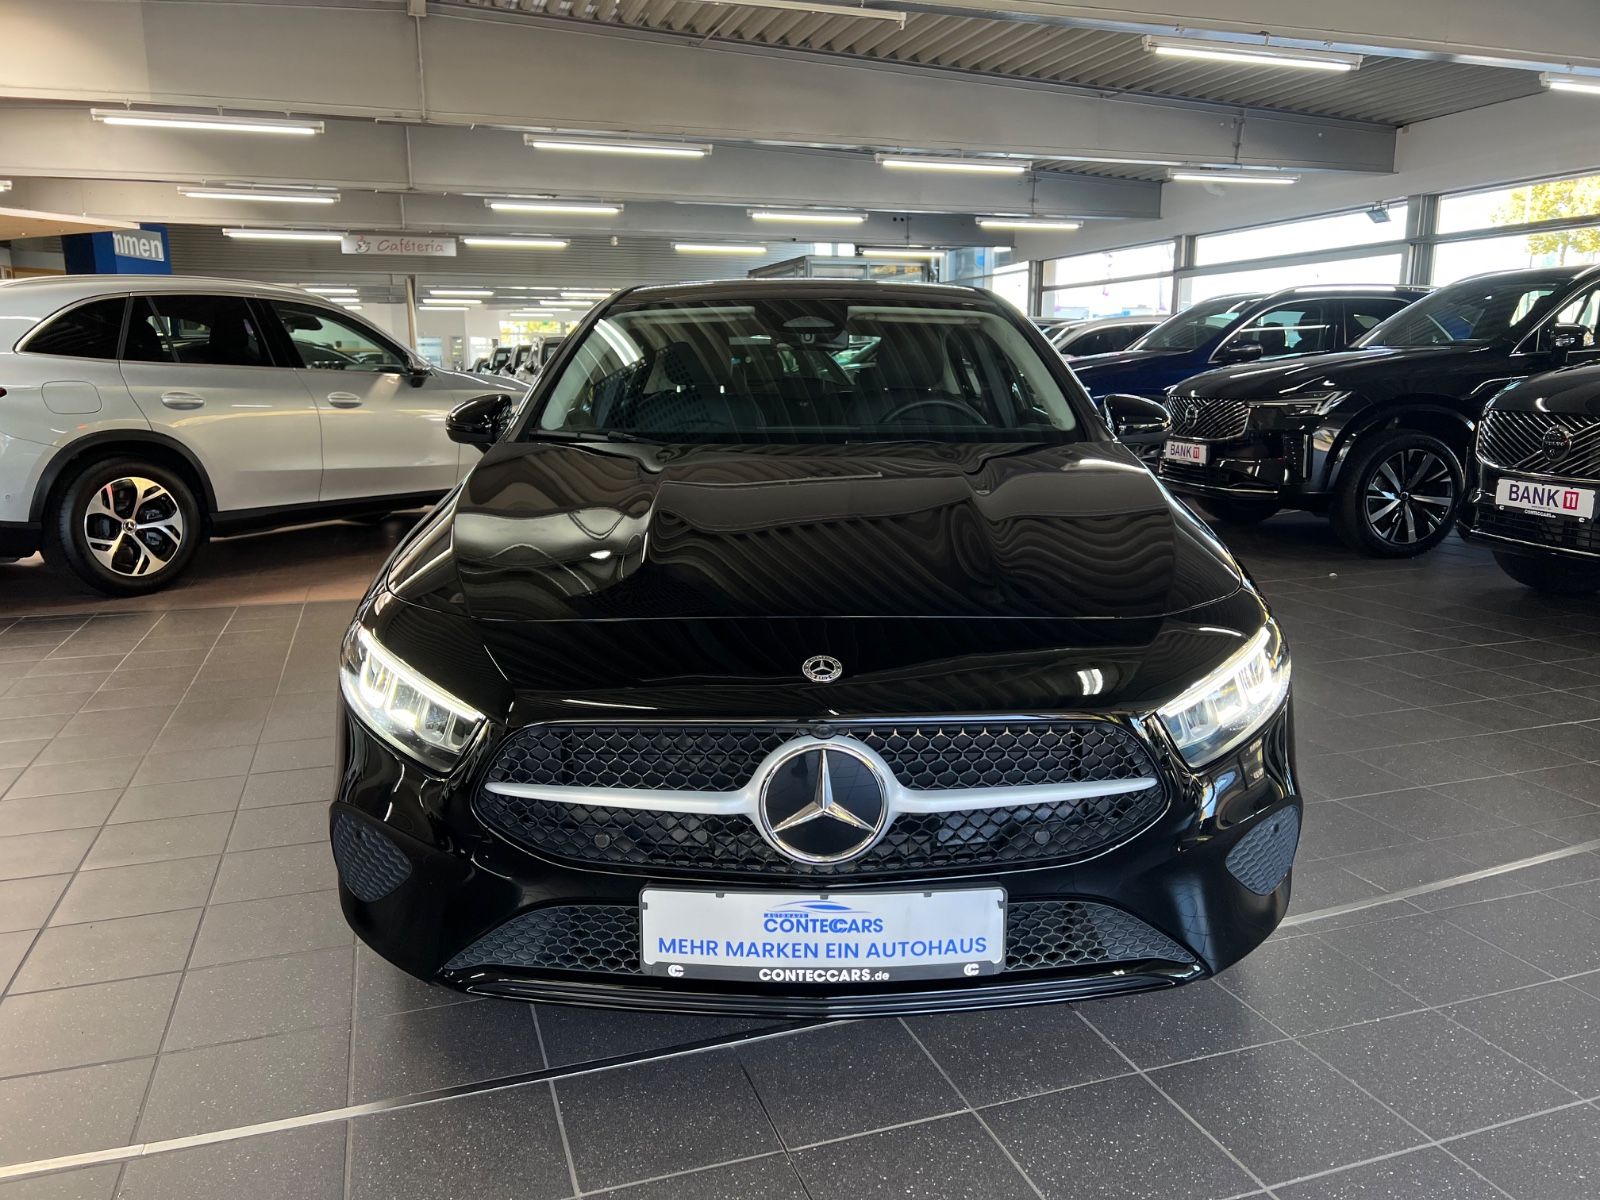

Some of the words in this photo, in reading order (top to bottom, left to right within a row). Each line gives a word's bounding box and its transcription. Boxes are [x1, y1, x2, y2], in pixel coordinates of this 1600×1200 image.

[1170, 444, 1191, 458] BANK
[1509, 484, 1559, 507] BANK
[658, 937, 718, 956] MEHR
[725, 941, 818, 958] MARKEN
[826, 943, 859, 958] EIN
[866, 937, 987, 958] AUTOHAUS
[758, 968, 890, 982] CONTECCARS.de
